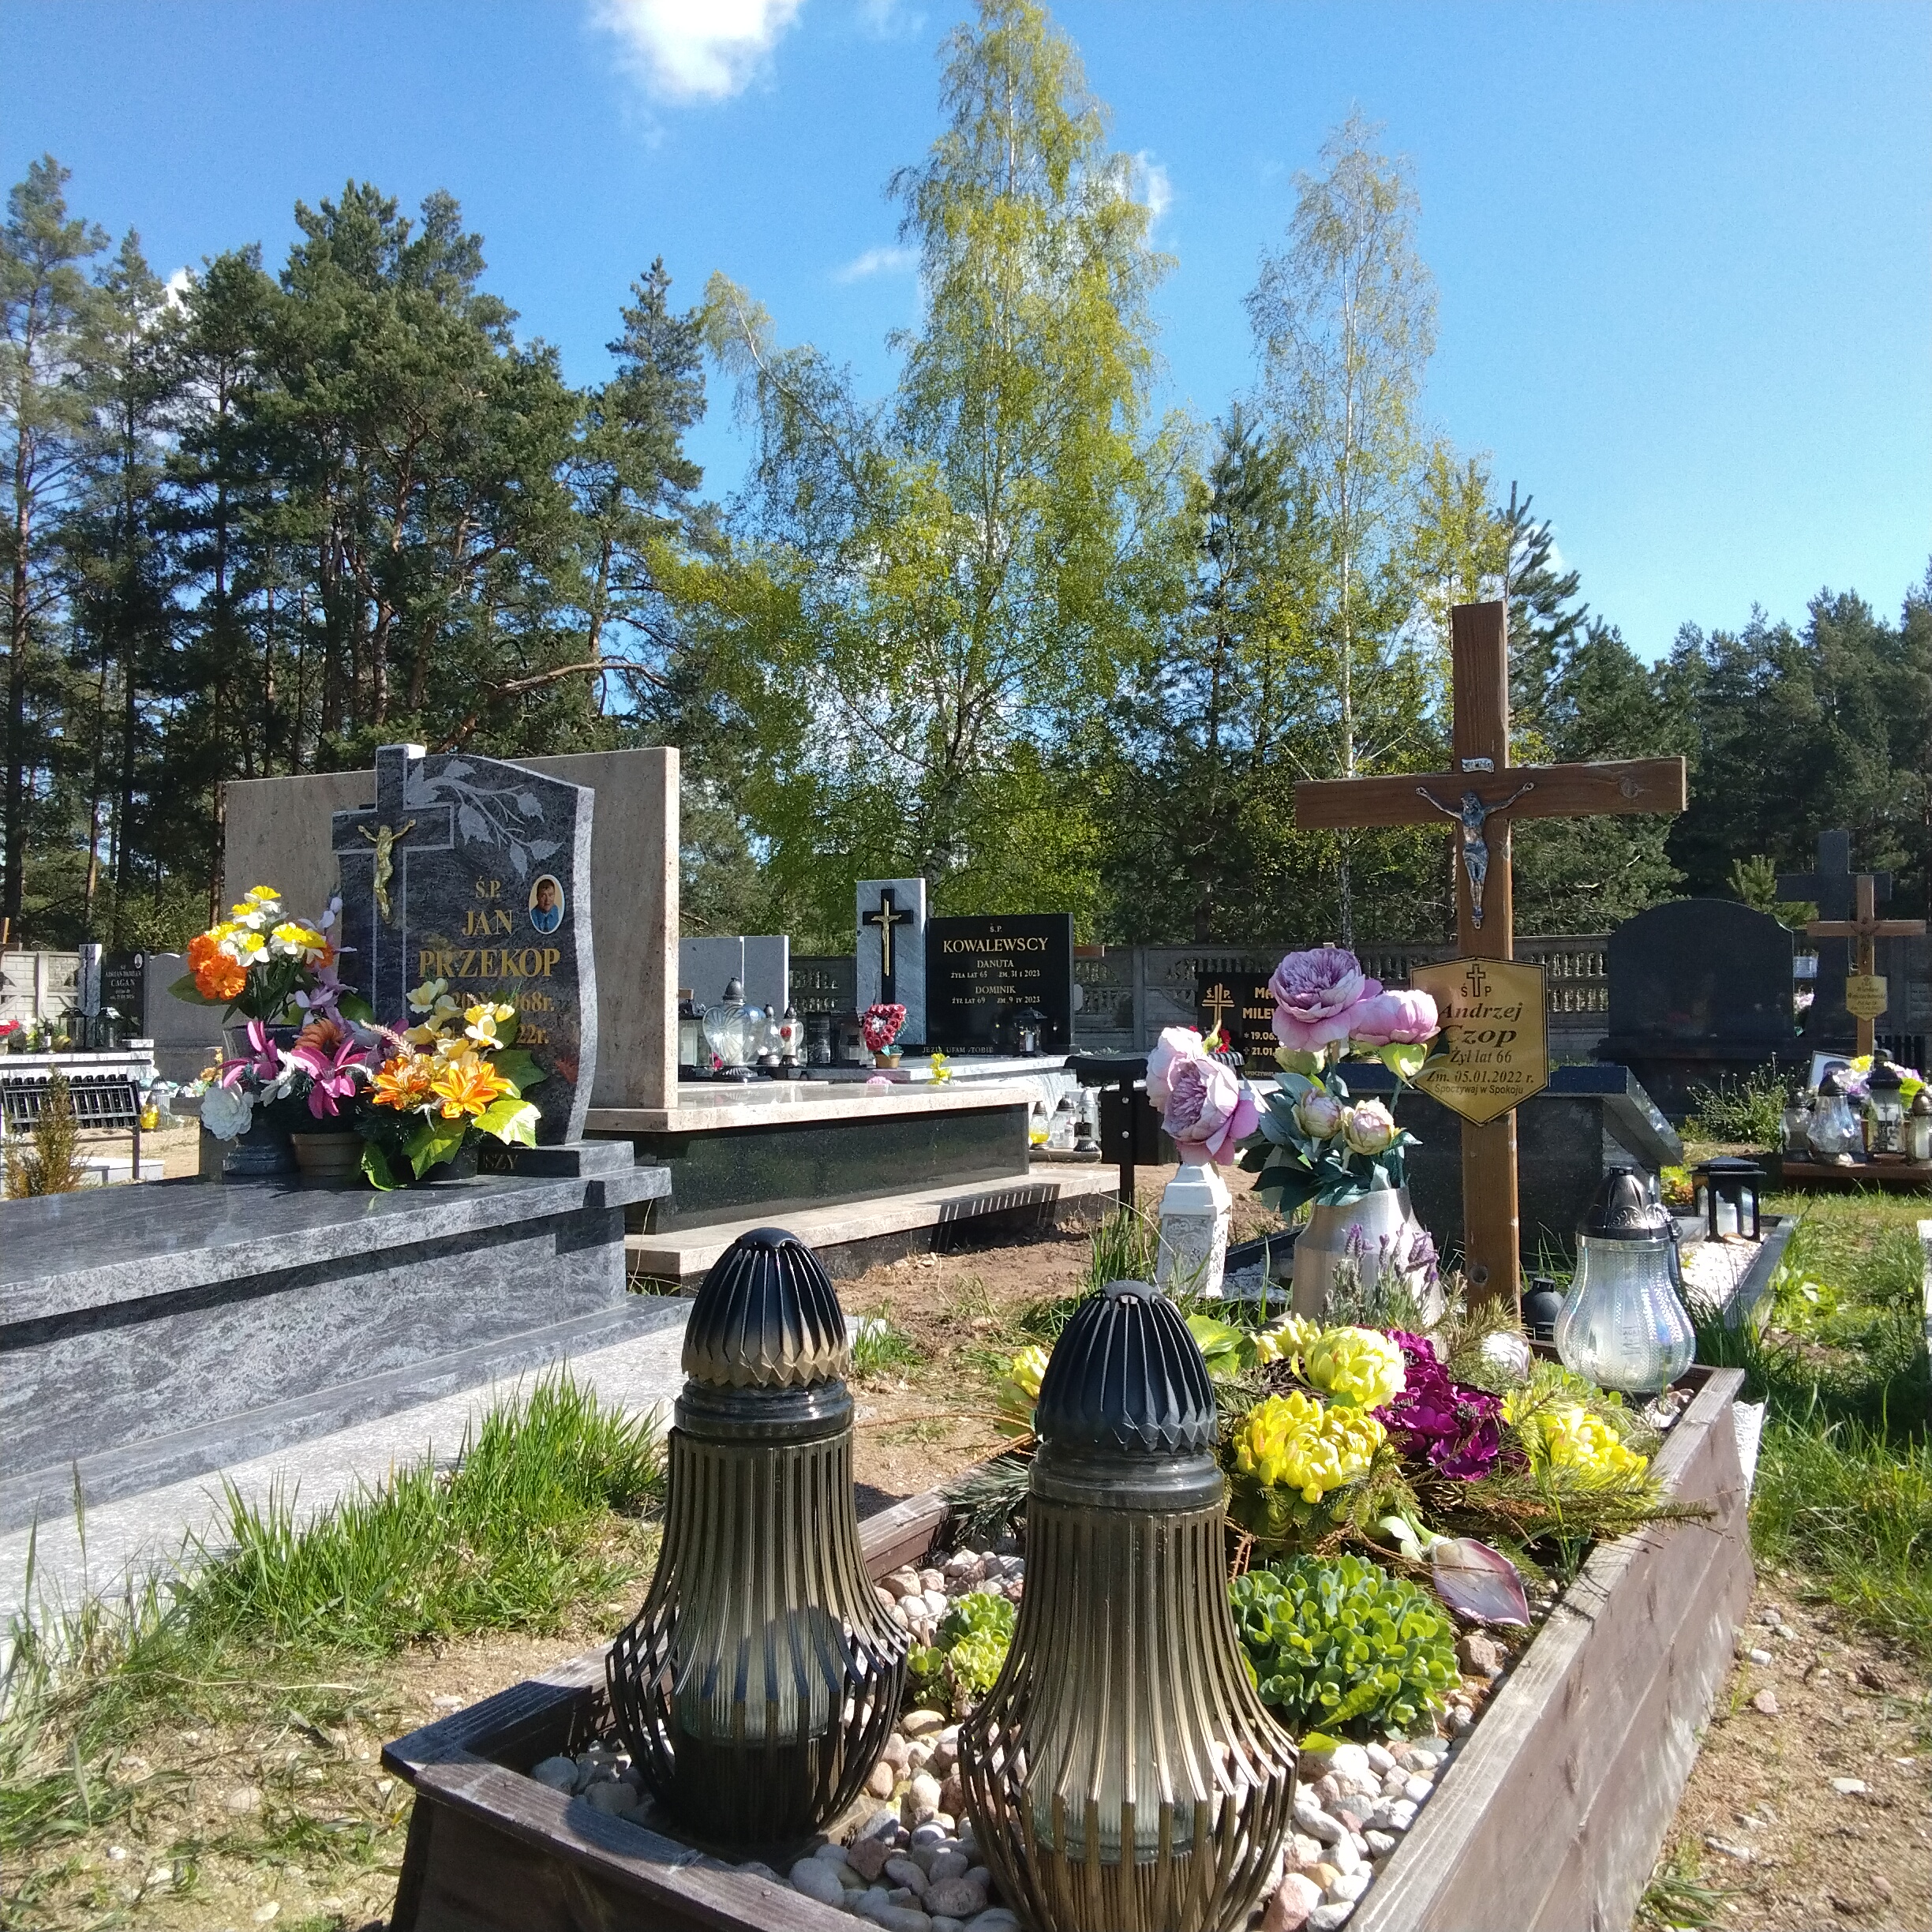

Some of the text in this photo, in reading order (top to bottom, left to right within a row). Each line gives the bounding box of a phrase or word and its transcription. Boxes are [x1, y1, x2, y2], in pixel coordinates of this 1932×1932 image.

[475, 875, 501, 898] Ś.P.
[462, 909, 512, 936] JAN
[942, 937, 1049, 953] KOWALEWSCY
[418, 948, 560, 978] PRZEKOP
[976, 959, 1014, 968] DANUTA
[975, 985, 1017, 994] DOMINIK
[1254, 987, 1275, 999] MA
[1461, 983, 1492, 997] Ś P
[1024, 995, 1040, 1004] 2023
[1437, 1002, 1523, 1023] Andrzej
[1250, 1032, 1278, 1041] 19.06.
[1440, 1024, 1517, 1048] Czop
[1251, 1046, 1276, 1056] 21.01.
[1450, 1046, 1512, 1065] Żył lat 66
[1426, 1070, 1534, 1084] Zm. 05.01.2022 r.
[1434, 1084, 1478, 1095] Spoczywaj
[1488, 1084, 1524, 1096] Spokoju
